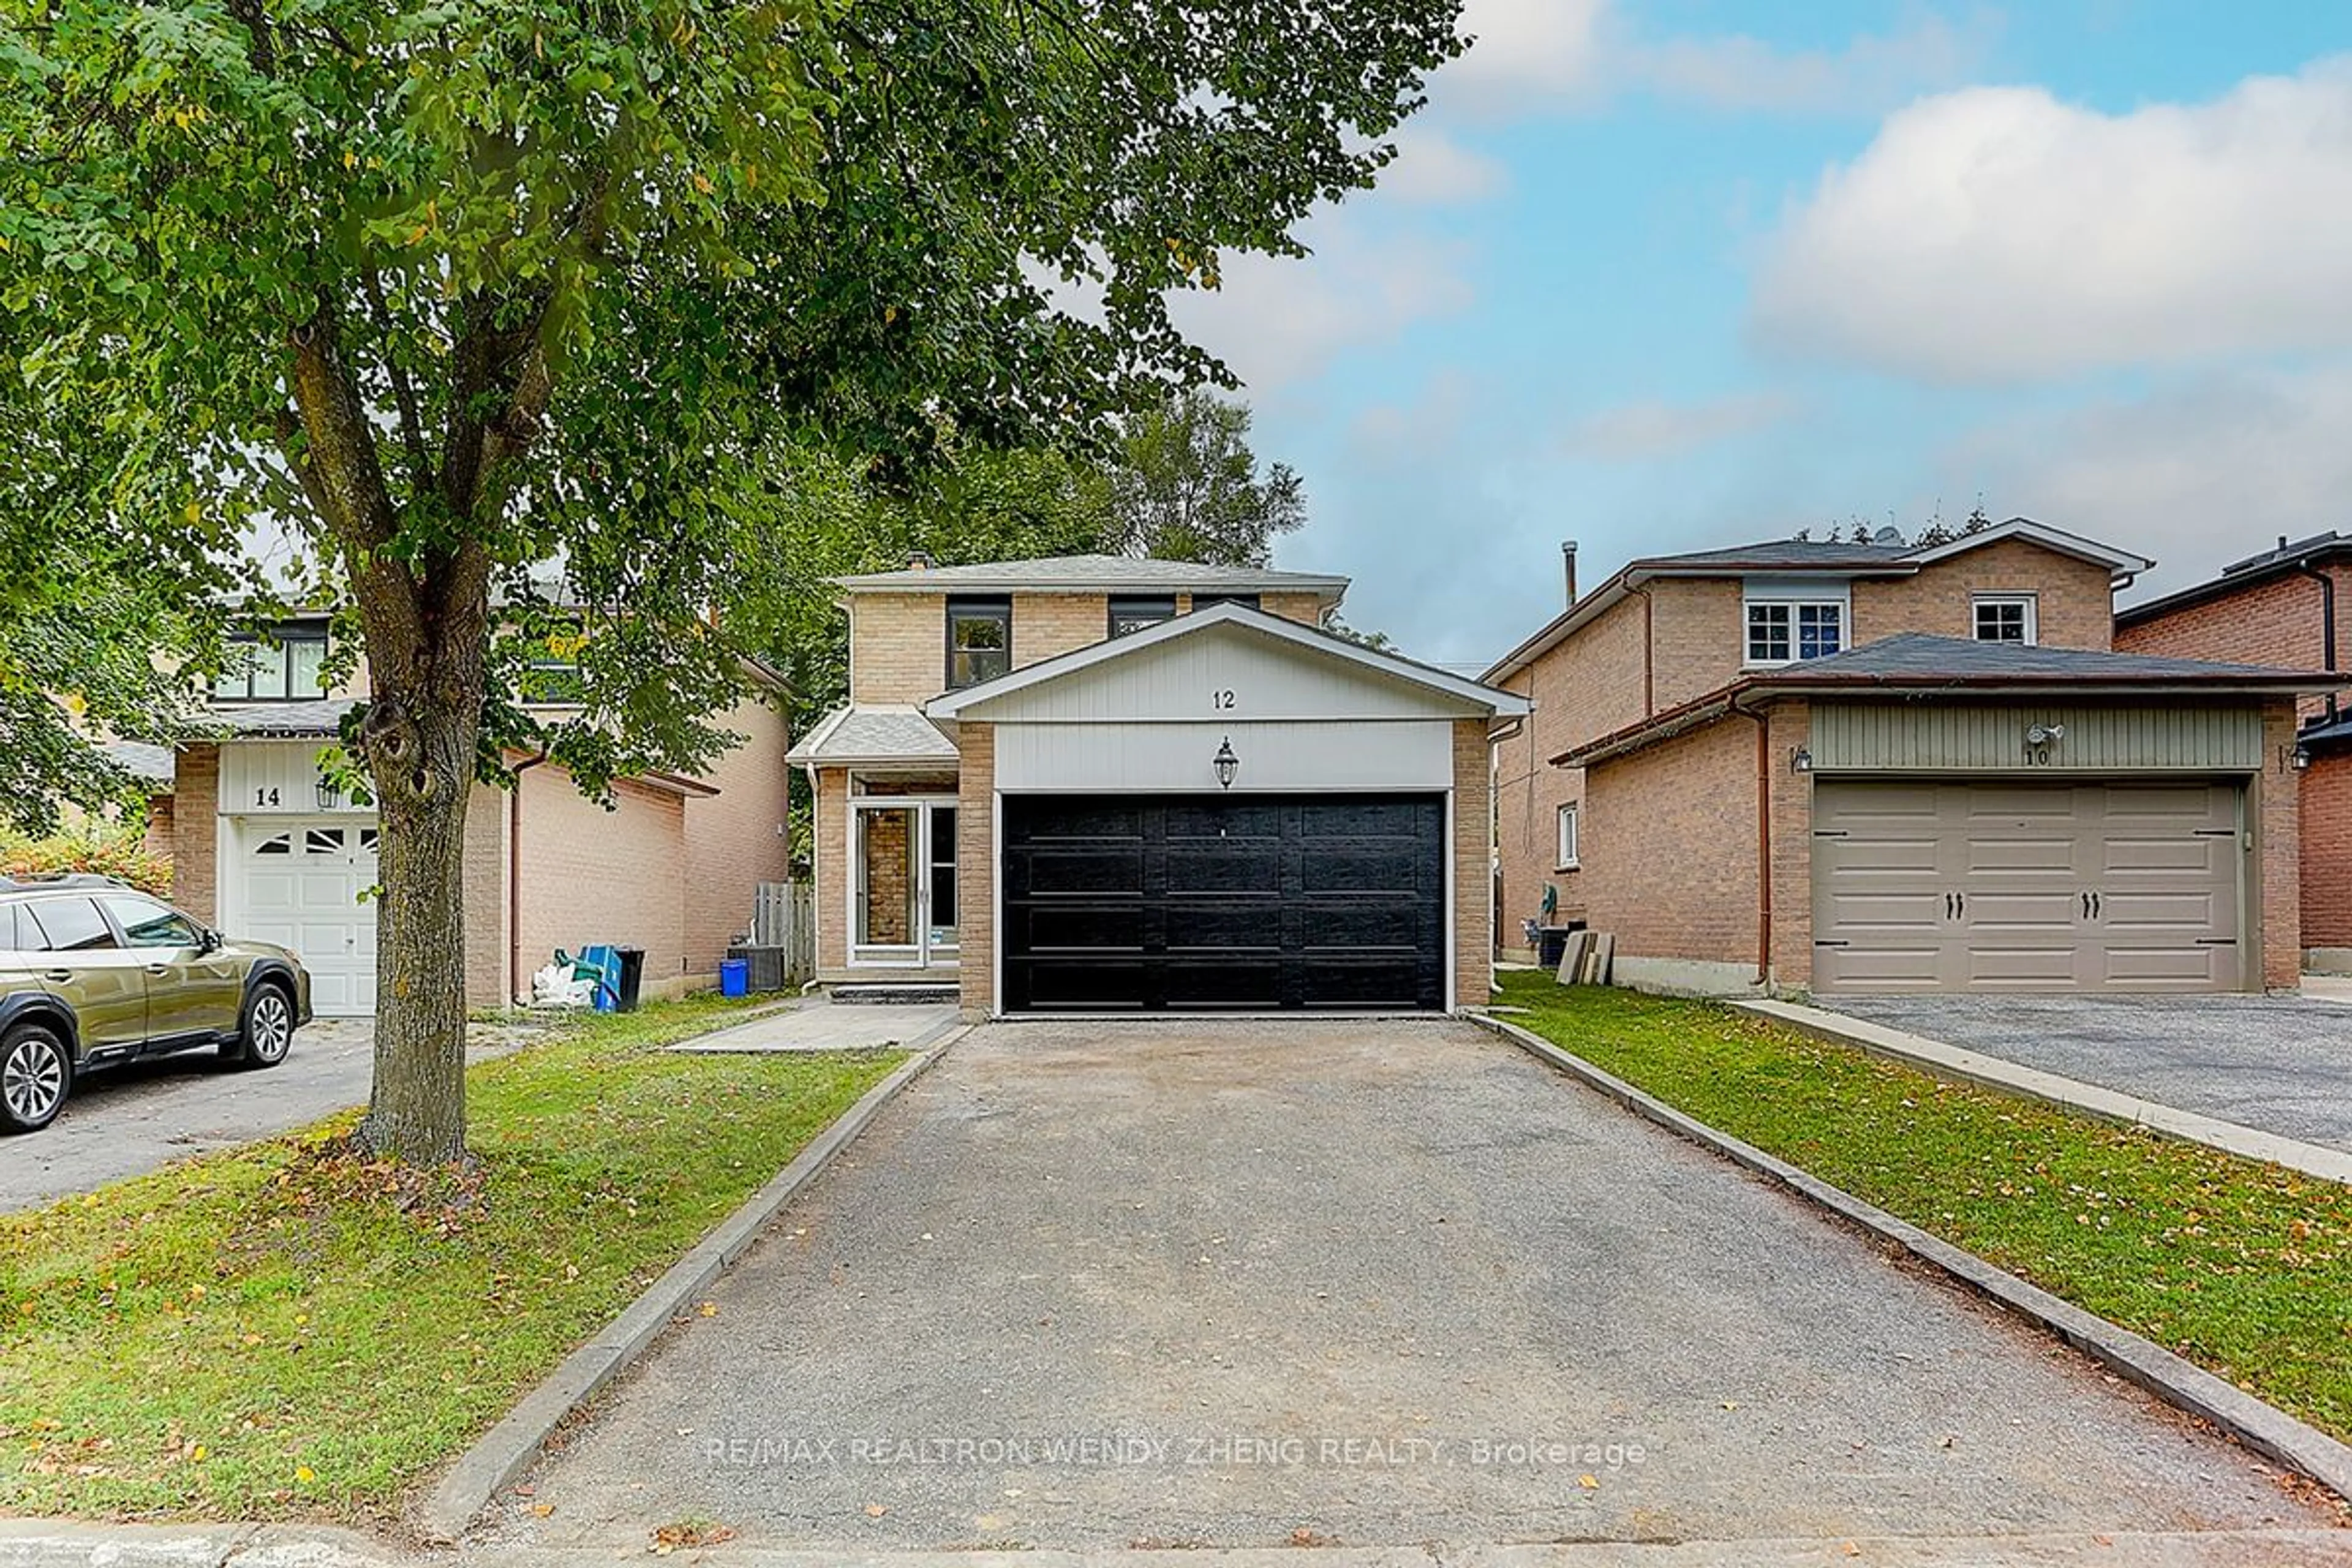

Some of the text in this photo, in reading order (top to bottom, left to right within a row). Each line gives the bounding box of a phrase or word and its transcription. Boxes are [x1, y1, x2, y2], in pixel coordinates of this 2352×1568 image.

[1213, 690, 1235, 709] 12
[2026, 750, 2047, 765] 10
[256, 788, 279, 807] 14
